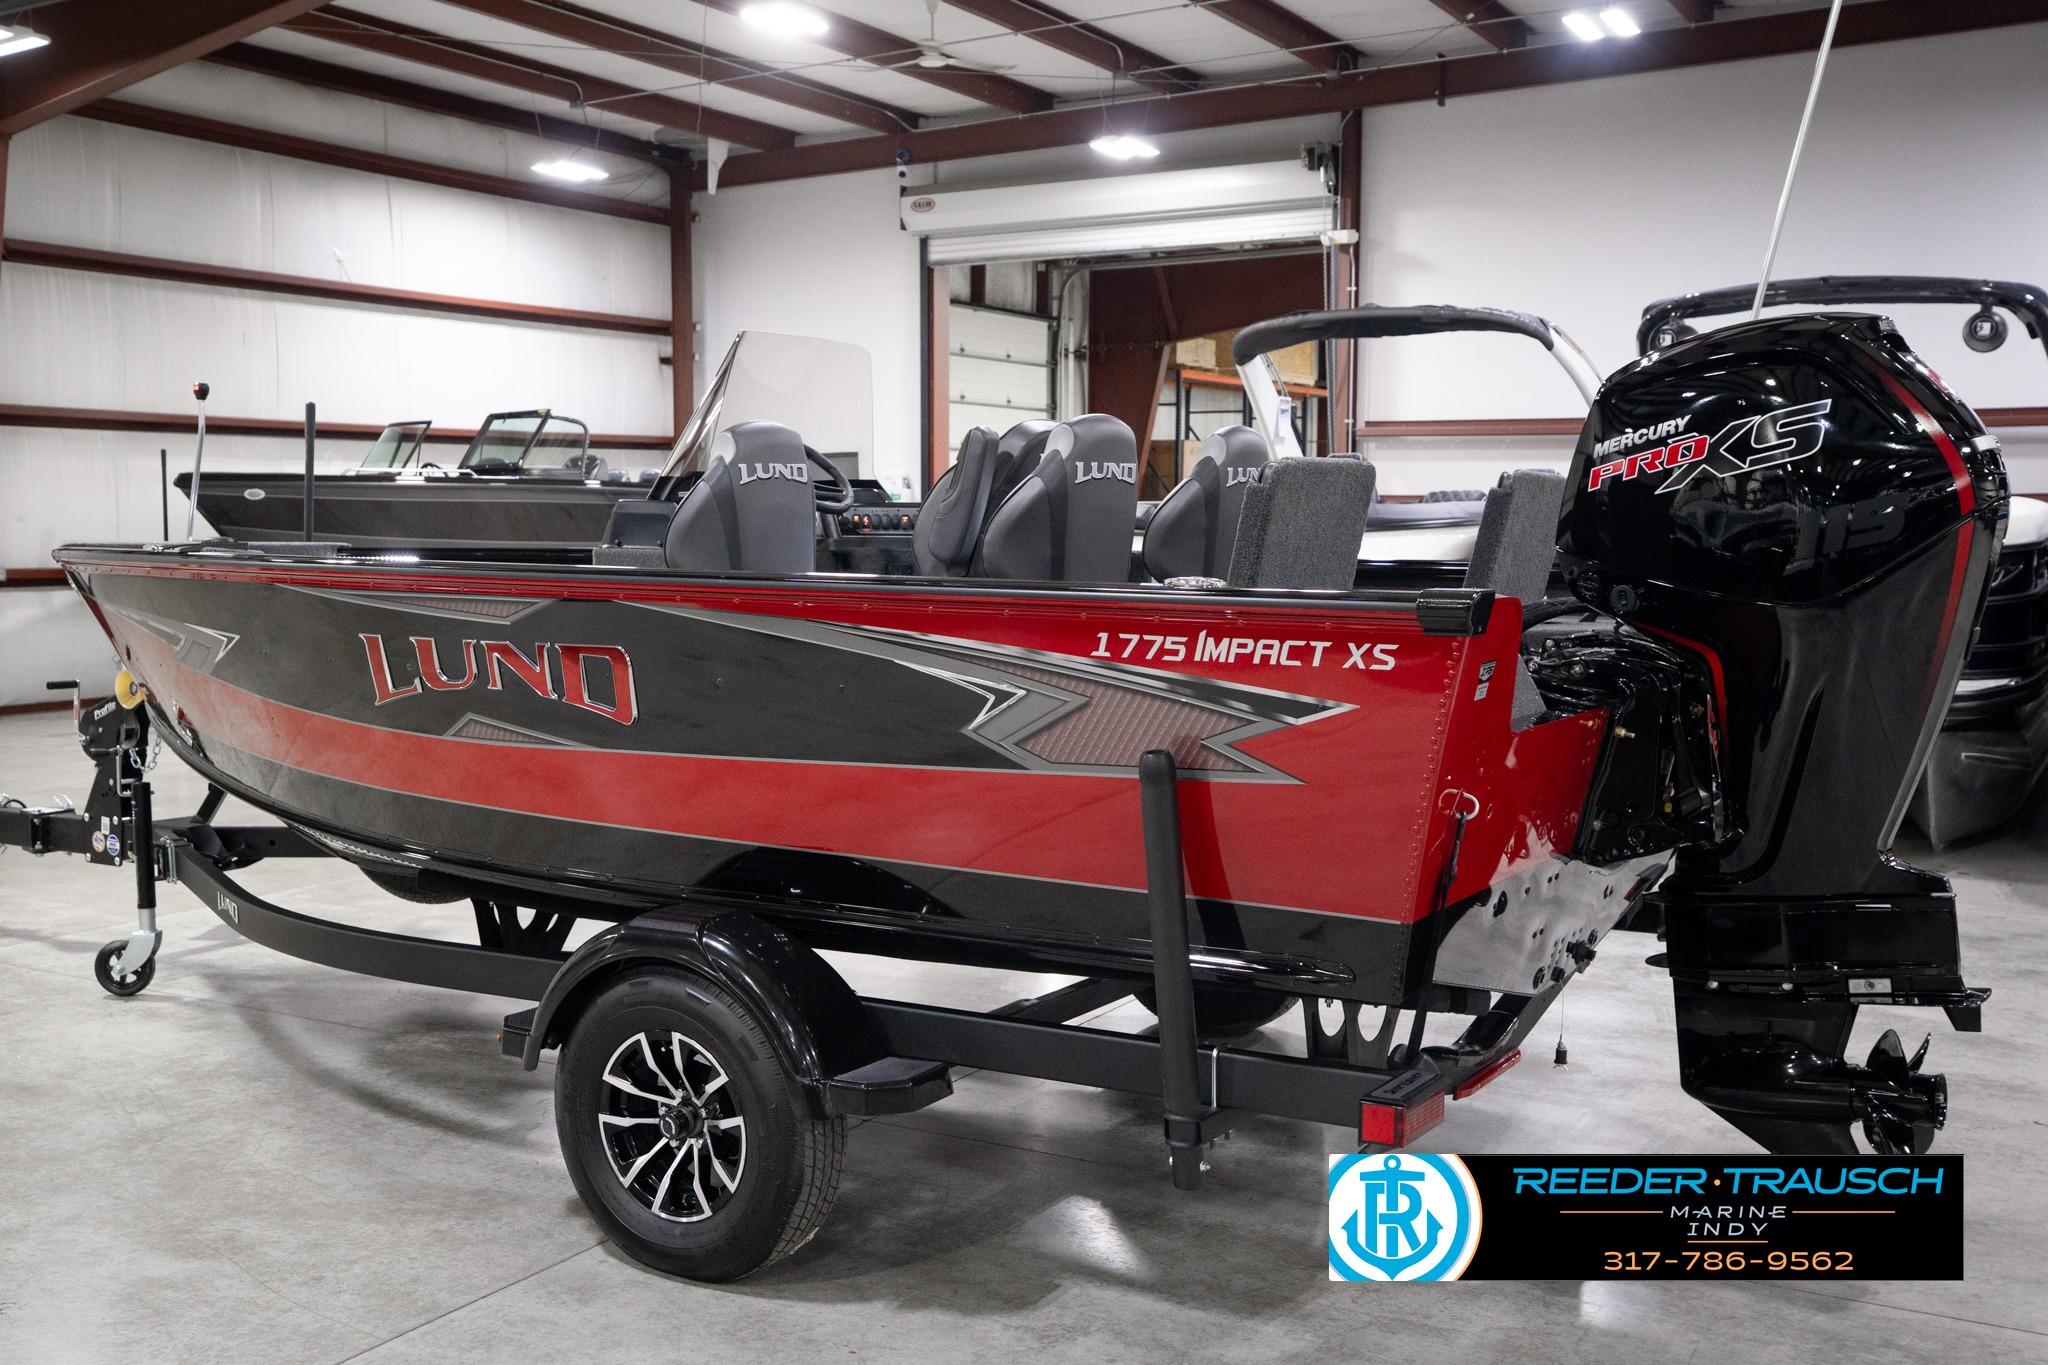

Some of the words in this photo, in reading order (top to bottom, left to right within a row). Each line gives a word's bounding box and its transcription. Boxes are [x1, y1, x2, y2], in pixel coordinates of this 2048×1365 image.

[1588, 434, 1710, 492] PRO
[1654, 398, 1833, 495] XS
[1593, 414, 1692, 459] MERCURY
[738, 463, 808, 485] LUND
[1075, 462, 1138, 485] LUND
[1226, 467, 1261, 487] LUN
[1090, 632, 1189, 662] 1775
[1194, 629, 1333, 668] IMPACT
[1342, 642, 1400, 671] XS
[358, 633, 638, 725] LUND
